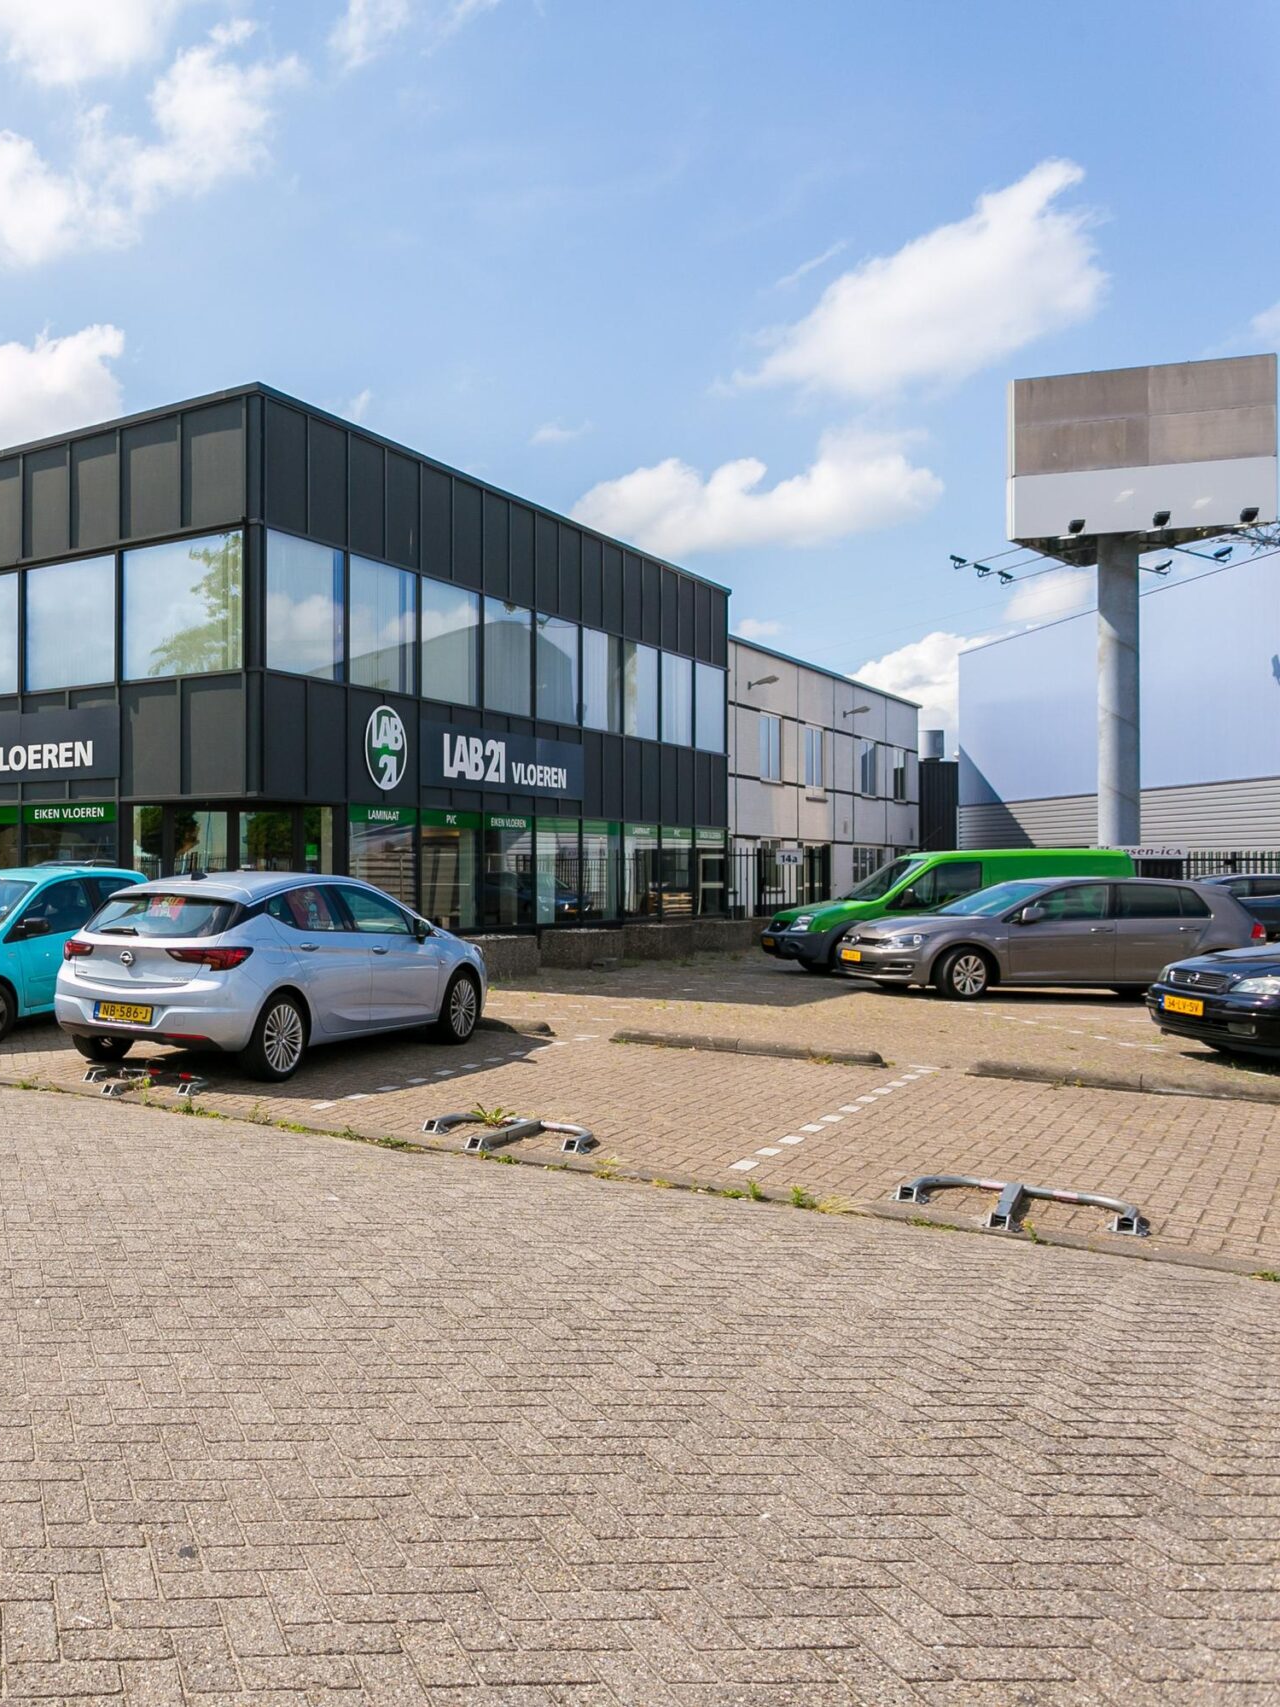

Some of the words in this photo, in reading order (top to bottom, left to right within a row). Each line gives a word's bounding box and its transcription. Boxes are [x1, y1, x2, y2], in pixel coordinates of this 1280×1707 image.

[371, 712, 404, 750] LAB
[378, 754, 397, 787] 21
[511, 761, 568, 790] VLOEREN
[34, 808, 60, 820] EIKEN
[61, 805, 105, 819] VLOEREN
[367, 809, 400, 821] LAMINAAT
[446, 814, 457, 825] PVC
[490, 816, 506, 827] EIKEN
[505, 818, 527, 829] VLOEREN
[780, 854, 798, 864] 14a
[101, 1002, 149, 1020] NB-586-J
